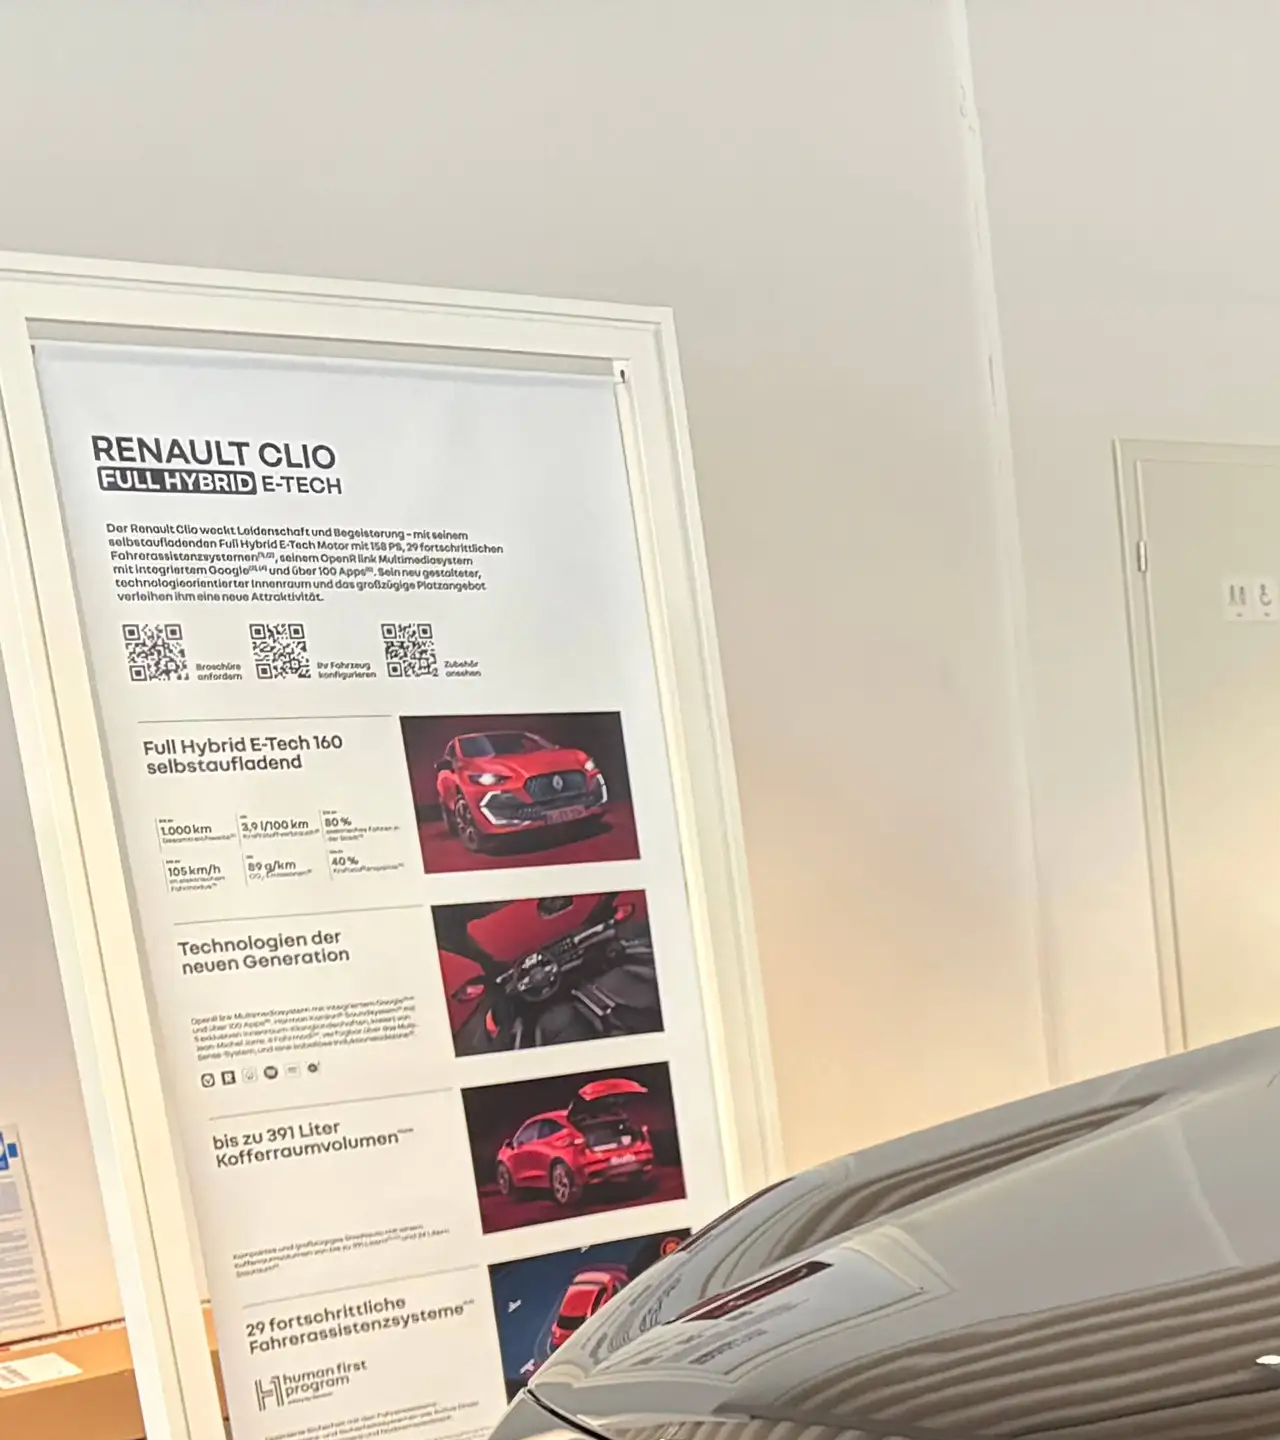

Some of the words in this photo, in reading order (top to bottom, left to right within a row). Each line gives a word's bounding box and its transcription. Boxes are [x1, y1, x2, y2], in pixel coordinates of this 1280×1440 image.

[91, 435, 250, 466] RENAULT
[258, 442, 336, 470] CLIO
[101, 469, 161, 490] FULL
[164, 472, 254, 492] HYBRID
[262, 475, 342, 495] E-TECH
[106, 523, 128, 535] Der
[130, 523, 175, 535] Renault
[176, 524, 199, 536] Clio
[200, 525, 236, 537] weckt
[237, 526, 311, 538] Leidenschaft
[311, 528, 332, 538] und
[333, 528, 405, 541] Begeisterung
[413, 529, 431, 540] mit
[431, 530, 468, 540] seinem
[108, 536, 217, 549] selbstaufladenden
[219, 538, 239, 549] Full
[240, 538, 278, 551] Hybrid
[279, 539, 316, 551] E-Tech
[317, 541, 350, 551] Motor
[351, 542, 370, 551] mit
[371, 541, 387, 552] 158
[406, 542, 419, 552] 29
[419, 543, 504, 554] fortschrittlichen
[279, 553, 319, 564] seinem
[320, 554, 357, 565] OpenR
[357, 554, 377, 565] link
[378, 555, 473, 567] Multimediasystem
[113, 564, 134, 575] mit
[135, 565, 207, 577] integriertem
[269, 566, 290, 576] und
[291, 566, 316, 576] über
[317, 566, 337, 577] 100
[377, 567, 401, 577] Sein
[402, 569, 421, 578] neu
[422, 568, 482, 580] gestalteter,
[115, 577, 249, 590] technologieorientierter
[251, 579, 312, 590] Innenraum
[313, 580, 334, 589] und
[335, 580, 355, 590] das
[356, 580, 416, 592] großzügige
[416, 581, 487, 593] Platzangebot
[117, 591, 173, 602] verleihen
[174, 591, 196, 602] ihm
[196, 592, 221, 602] eine
[222, 592, 249, 602] neue
[251, 591, 325, 602] Attraktivität.
[195, 662, 241, 672] Broschüre
[330, 661, 371, 671] Fahrzeug
[444, 660, 479, 668] Zubehör
[197, 672, 243, 681] anfordern
[318, 671, 377, 681] konfigurieren
[143, 739, 177, 756] Full
[181, 736, 247, 757] Hybrid
[250, 735, 311, 752] E-Tech
[313, 735, 343, 750] 160
[146, 754, 303, 775] selbstaufladend
[192, 824, 212, 834] km
[290, 819, 309, 829] km
[324, 817, 339, 827] 80
[340, 817, 352, 826] %
[248, 862, 262, 872] 89
[264, 860, 297, 874] g/km
[331, 857, 346, 866] 40
[347, 856, 359, 865] %
[168, 866, 187, 877] 105
[188, 864, 221, 876] km/h
[177, 932, 307, 957] Technologien
[311, 930, 342, 946] der
[182, 958, 240, 976] neuen
[243, 948, 351, 970] Generation
[212, 1133, 239, 1151] bis
[242, 1131, 264, 1146] zu
[266, 1126, 296, 1143] 391
[299, 1121, 341, 1140] Liter
[245, 1320, 266, 1338] 29
[269, 1297, 406, 1333] fortschrittliche
[282, 1367, 335, 1385] human
[336, 1360, 368, 1374] first
[285, 1375, 350, 1398] program
